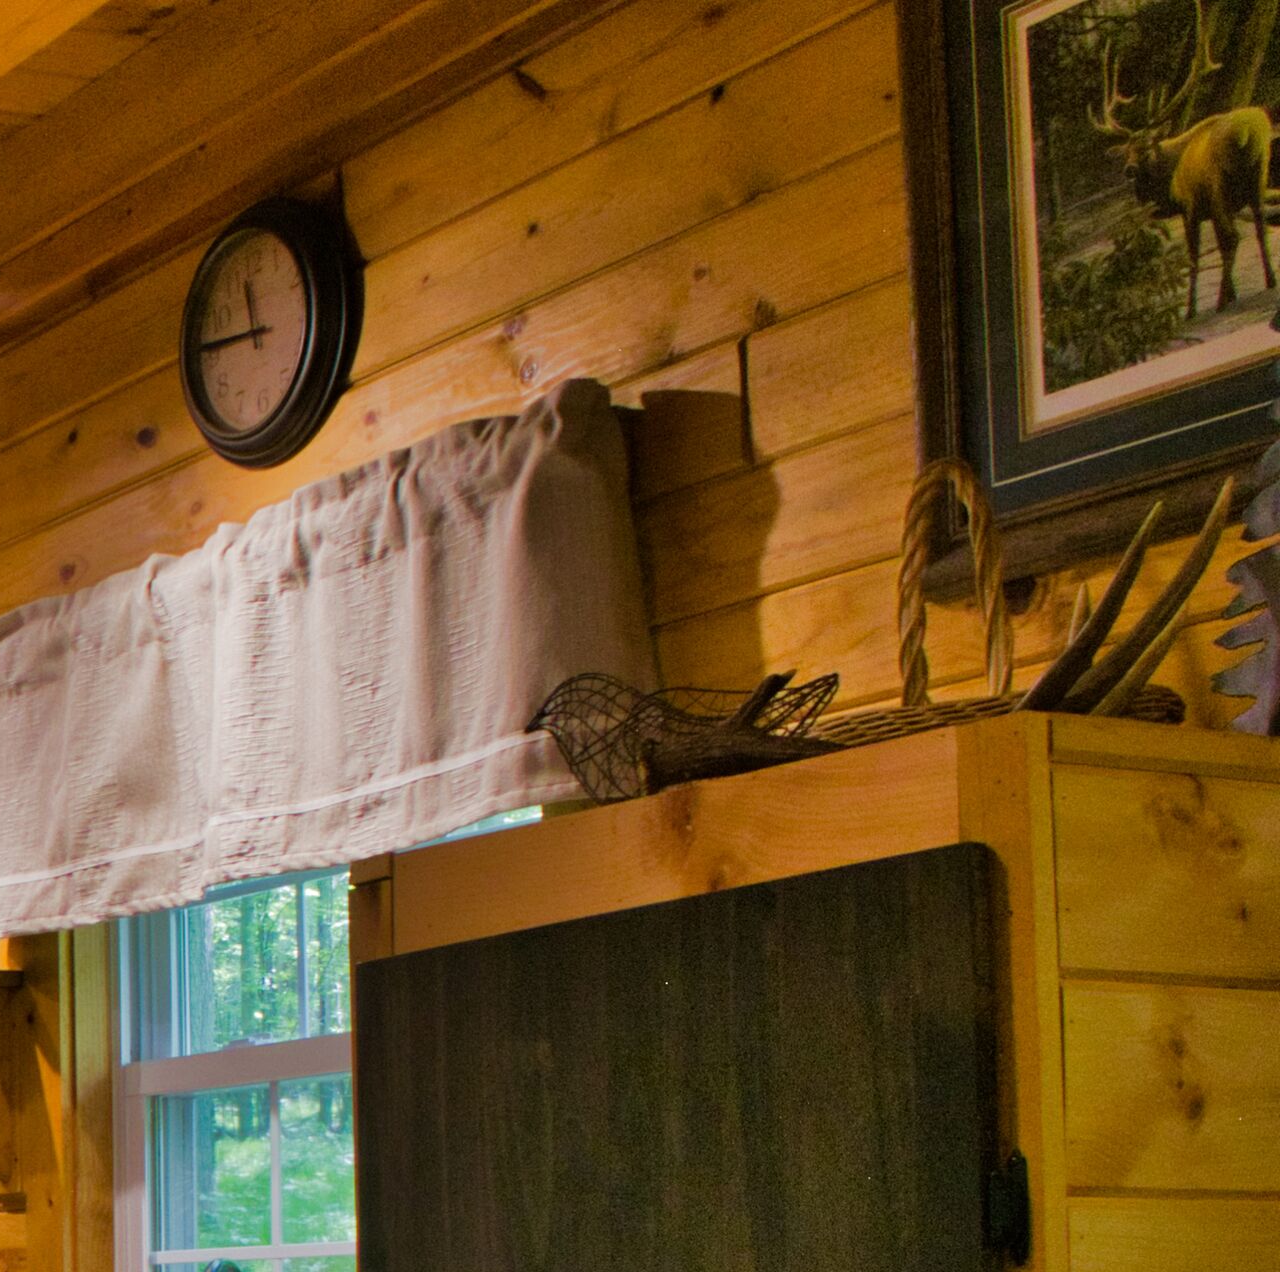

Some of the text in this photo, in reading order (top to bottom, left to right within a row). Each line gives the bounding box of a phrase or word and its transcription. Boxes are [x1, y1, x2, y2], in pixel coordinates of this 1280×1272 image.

[213, 306, 231, 334] 10
[217, 372, 229, 398] 8
[235, 389, 246, 413] 7
[256, 388, 269, 413] 6
